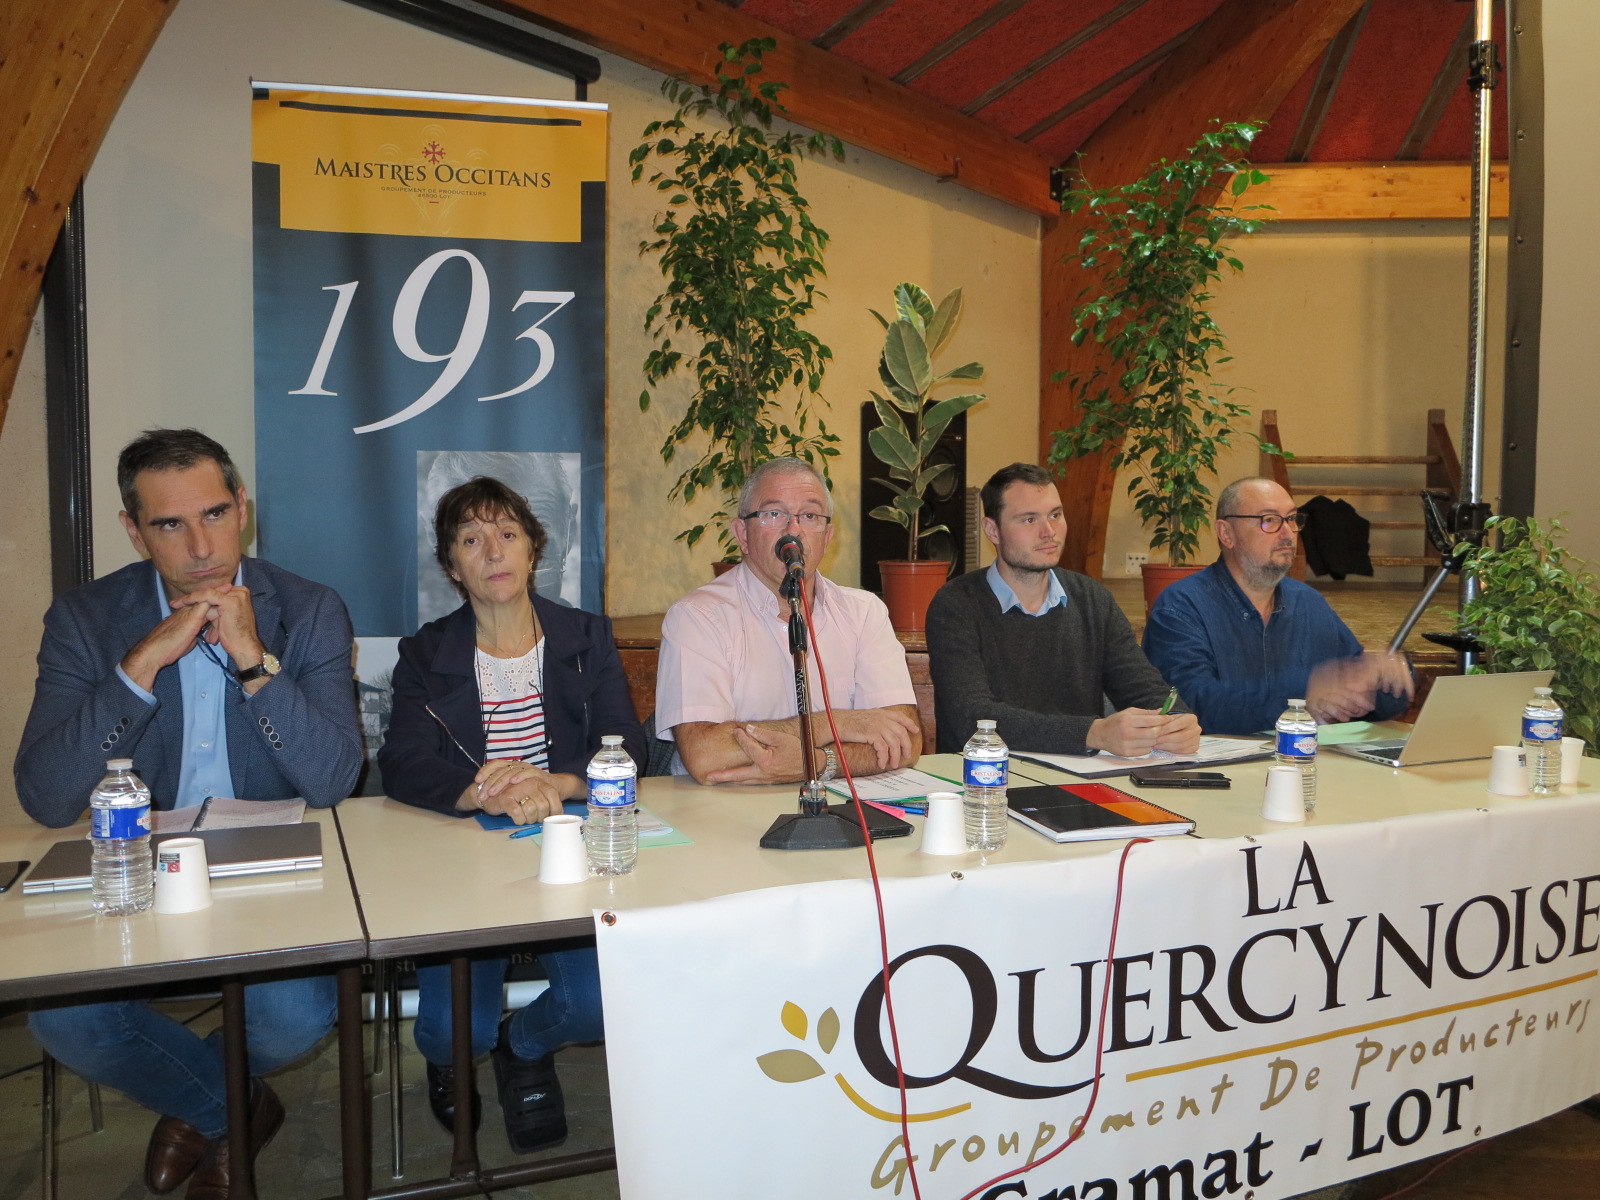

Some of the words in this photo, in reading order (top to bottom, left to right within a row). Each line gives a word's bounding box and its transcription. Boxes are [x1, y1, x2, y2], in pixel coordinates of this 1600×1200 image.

[314, 157, 426, 187] MAISTRES
[435, 164, 551, 188] OCCITANS
[381, 186, 427, 194] GROUPEMENT
[438, 189, 488, 197] PRODUCTEURS
[1239, 841, 1334, 918] LA
[854, 874, 1600, 1100] QUERCYNOISE
[871, 1073, 1234, 1196] Groupement
[1260, 1056, 1320, 1110] De
[1351, 999, 1592, 1090] Producteurs
[1347, 1075, 1474, 1161] LOT
